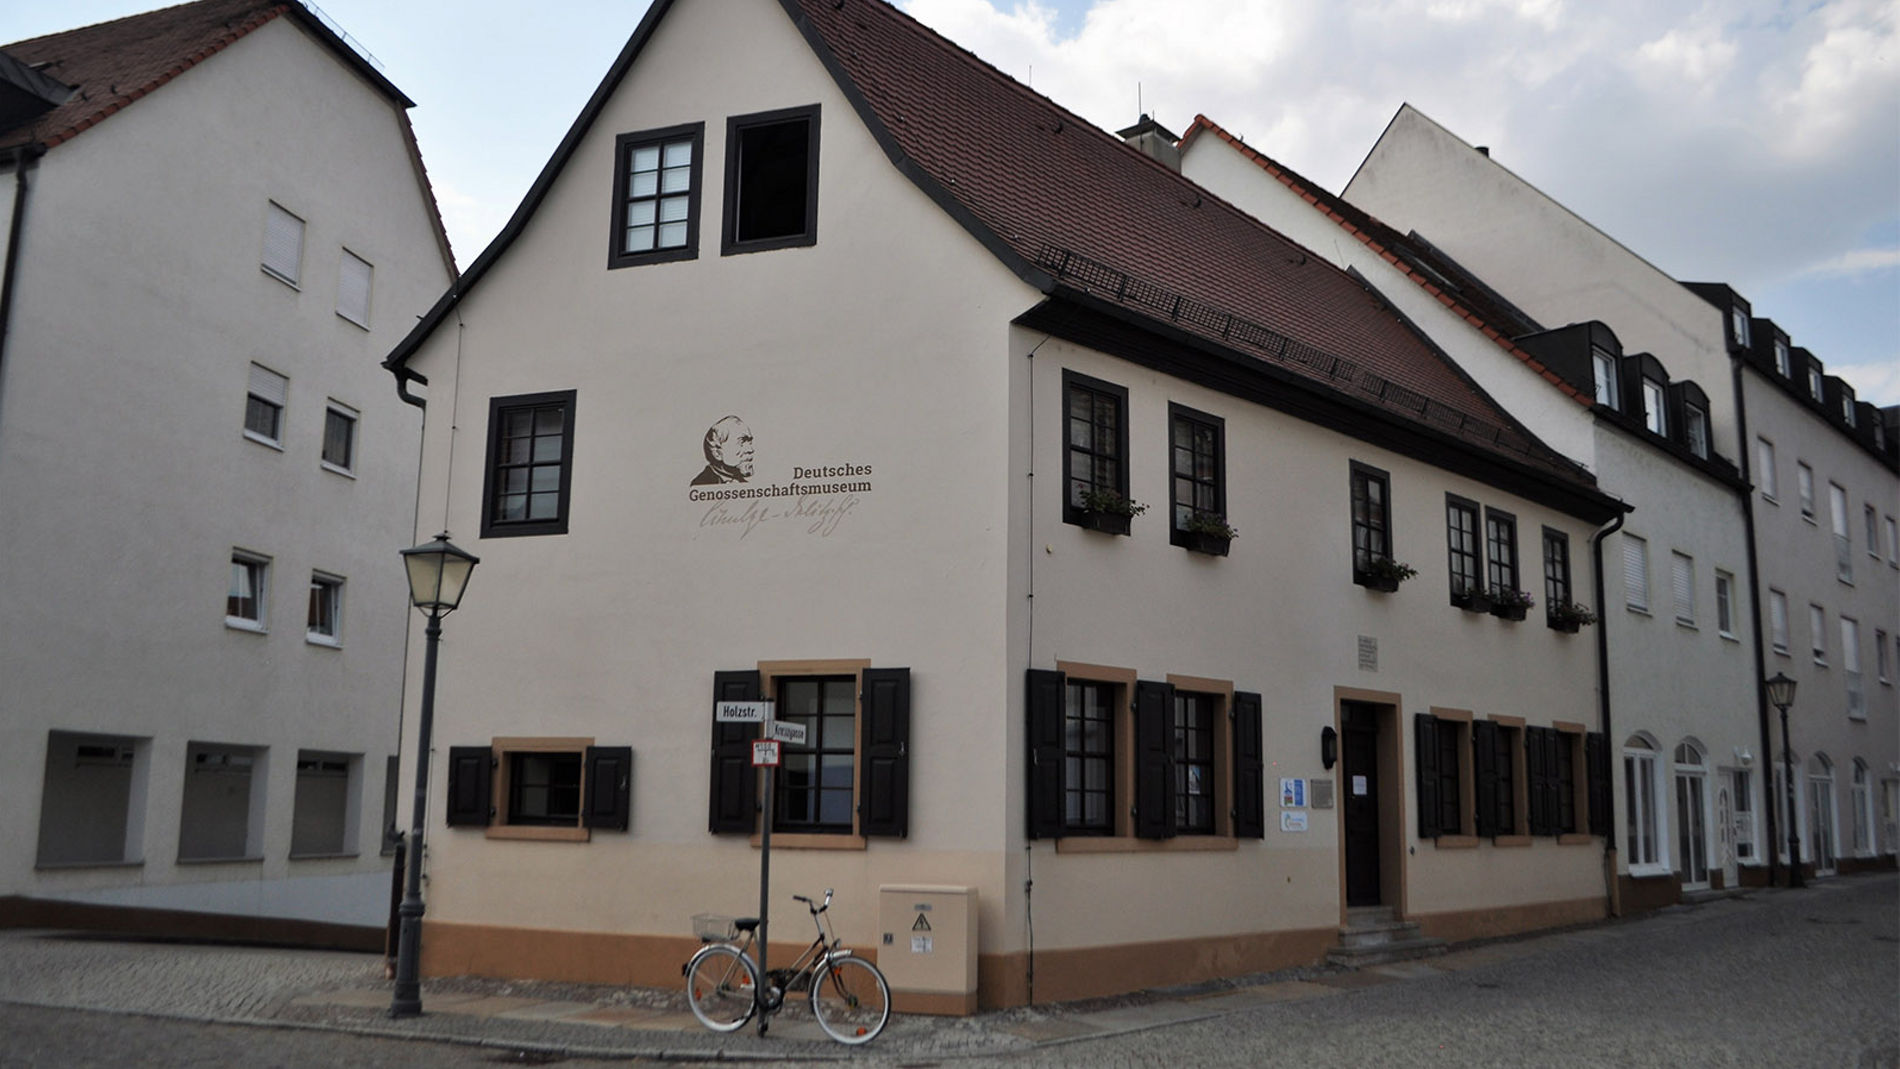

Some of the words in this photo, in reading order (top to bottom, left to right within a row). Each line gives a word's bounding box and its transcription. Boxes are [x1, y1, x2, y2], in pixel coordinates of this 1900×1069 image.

[793, 463, 872, 480] Deutsches
[689, 481, 872, 502] Genossenschaftsmuseum
[723, 705, 757, 718] Holzstr.
